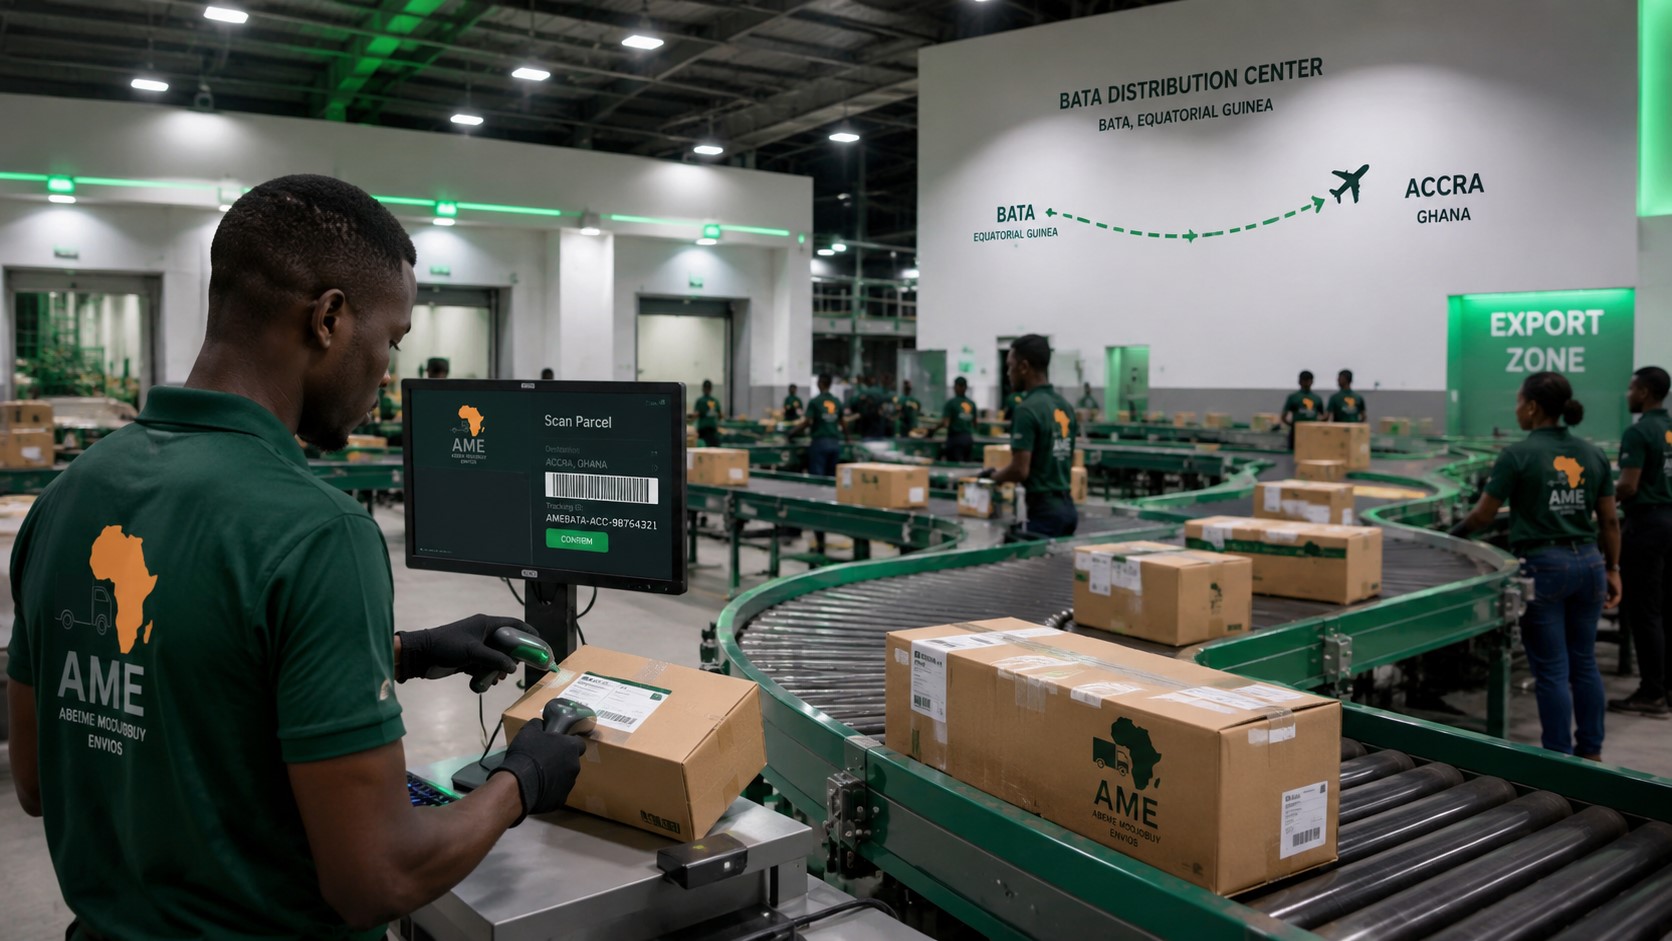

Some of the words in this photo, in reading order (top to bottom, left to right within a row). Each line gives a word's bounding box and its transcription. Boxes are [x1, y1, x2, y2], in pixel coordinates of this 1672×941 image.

[1059, 87, 1102, 110] BATA
[1108, 68, 1238, 104] DISTRIBUTION
[1244, 57, 1323, 86] CENTER
[1099, 116, 1134, 132] BATA,
[1137, 104, 1218, 127] EQUATORIAL
[1222, 98, 1273, 117] GUINEA
[1404, 173, 1485, 198] ACCRA
[997, 204, 1036, 223] BATA
[1417, 207, 1471, 224] GHANA
[973, 230, 1024, 242] EQUATORIAL
[1026, 227, 1058, 239] GUINEA
[1490, 309, 1605, 337] EXPORT
[1505, 347, 1586, 373] ZONE
[544, 414, 573, 427] Scan
[576, 415, 612, 428] Parcel
[452, 438, 485, 453] AME
[577, 459, 608, 469] GHANA
[1549, 489, 1585, 505] AME
[57, 650, 144, 717] AME
[88, 733, 123, 756] ENVIOS
[1093, 780, 1158, 830] AME
